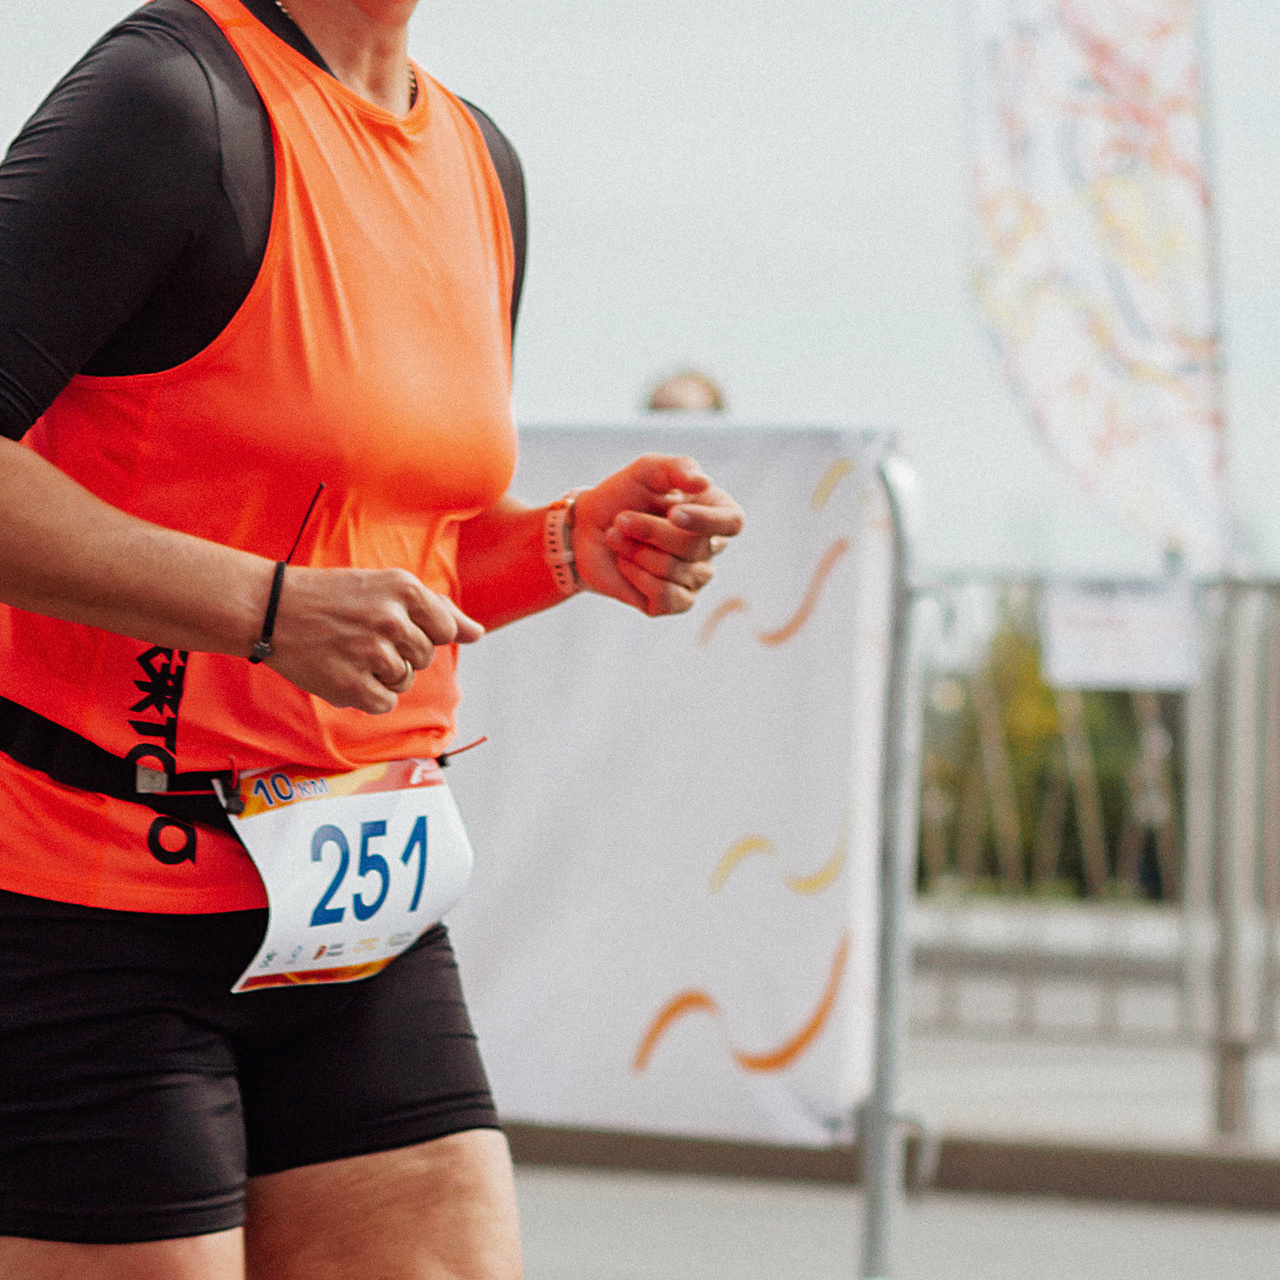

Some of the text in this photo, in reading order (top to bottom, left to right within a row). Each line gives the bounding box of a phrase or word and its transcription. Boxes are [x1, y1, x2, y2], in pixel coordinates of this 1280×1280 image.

[251, 772, 330, 807] 10 KM
[308, 815, 429, 928] 251
